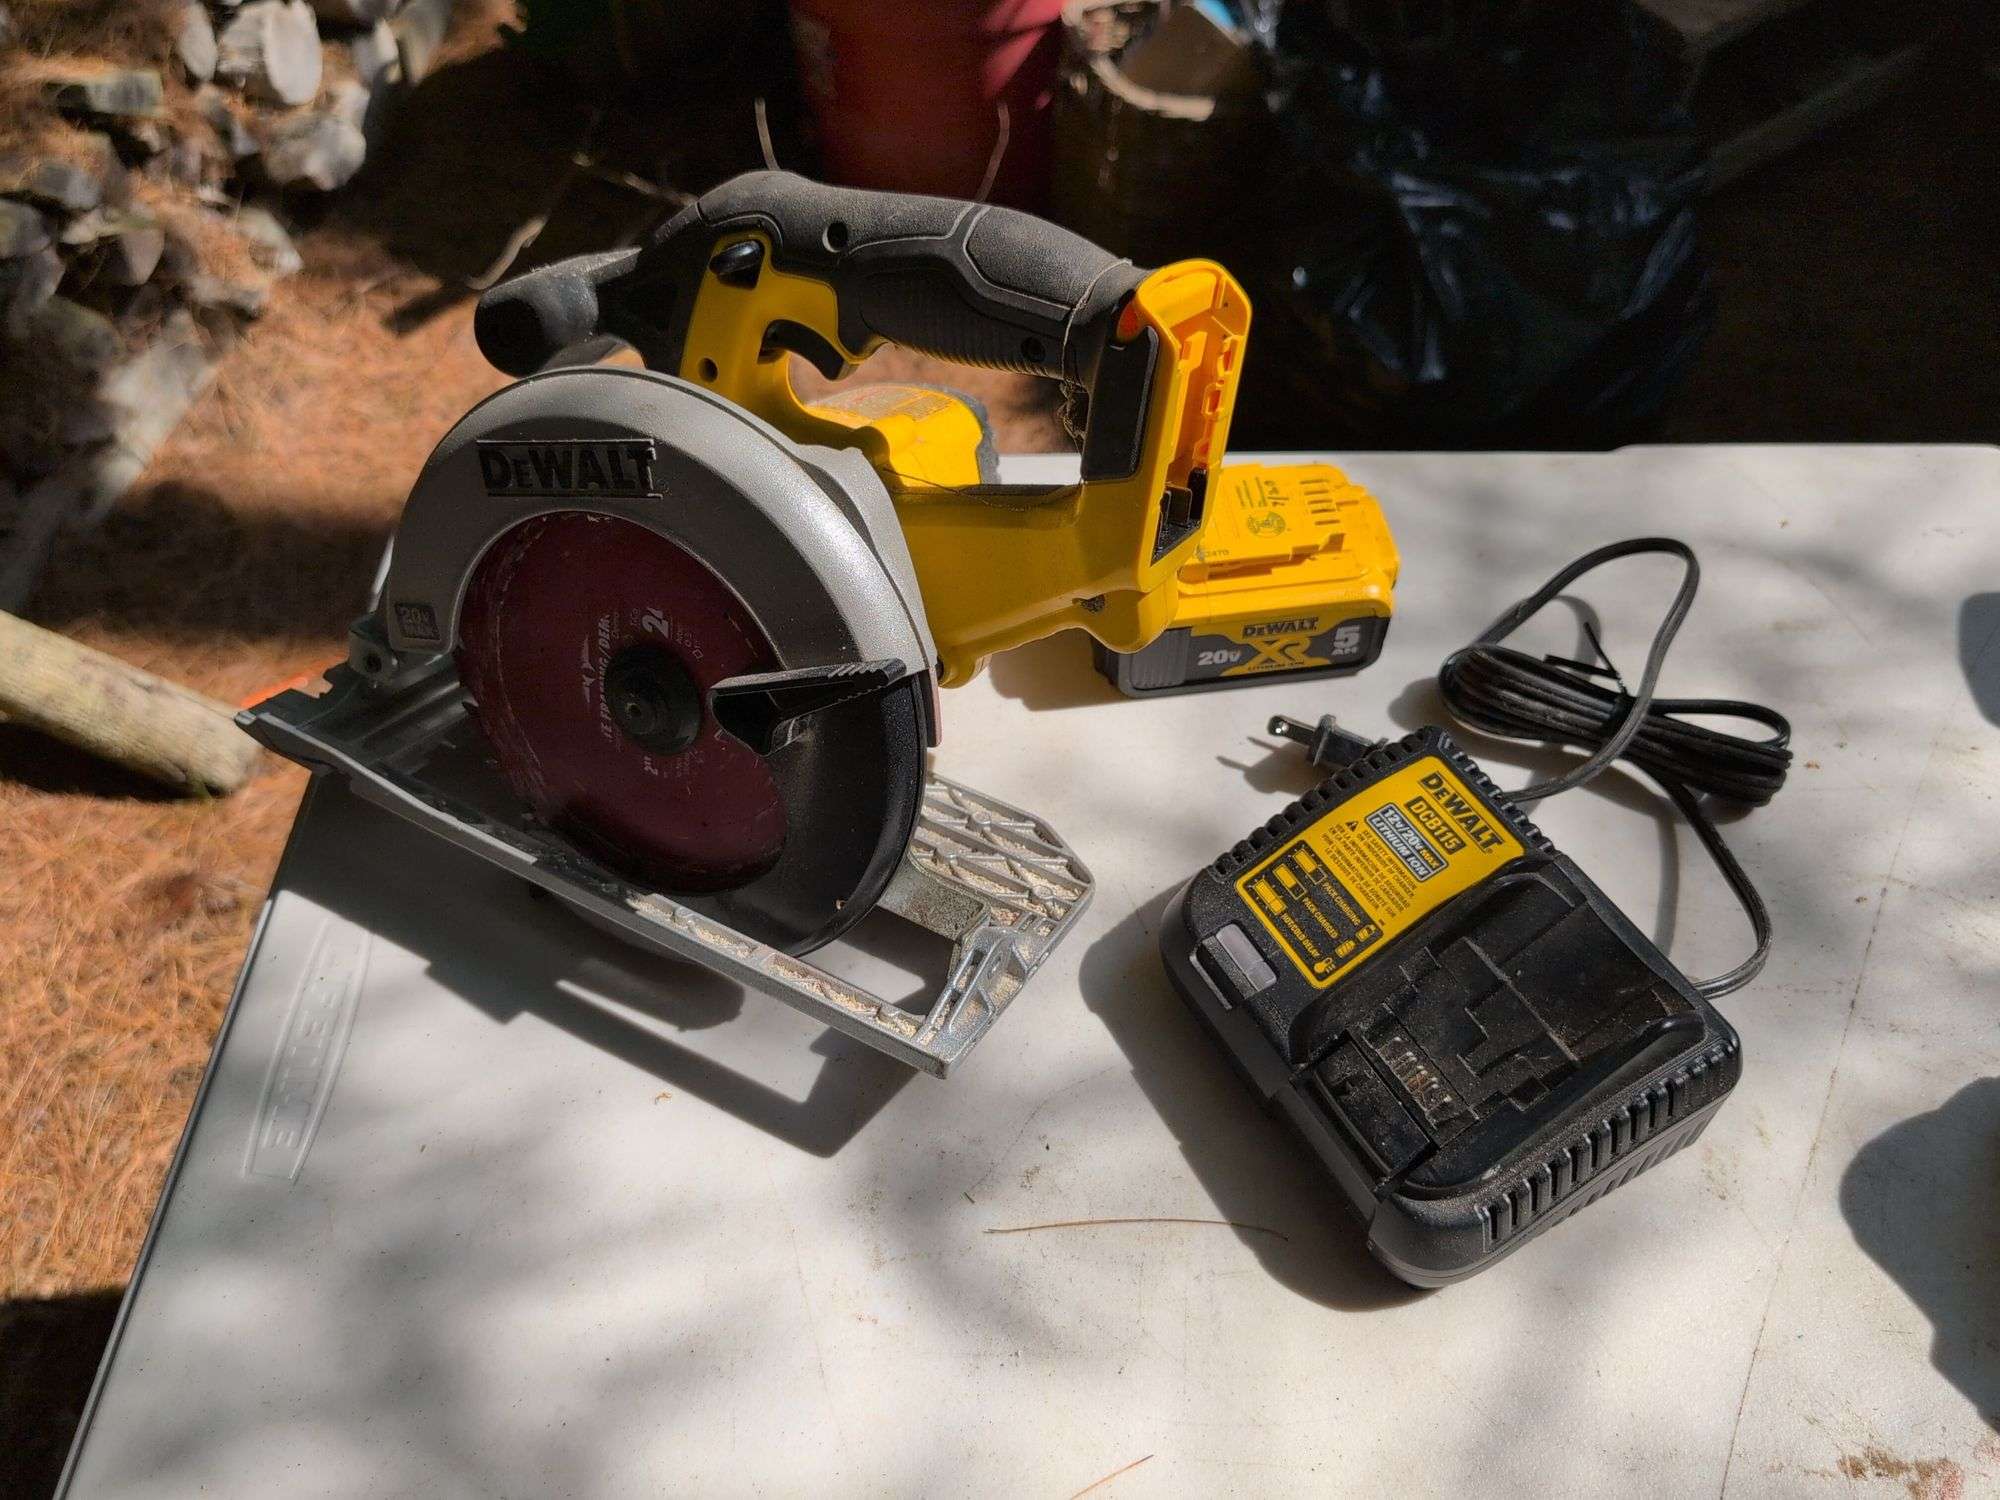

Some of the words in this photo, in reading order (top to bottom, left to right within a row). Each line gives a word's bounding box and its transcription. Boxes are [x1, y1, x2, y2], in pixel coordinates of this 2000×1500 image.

[479, 443, 657, 490] DEWALT
[1242, 617, 1319, 638] DEWALT
[1334, 625, 1361, 649] 5
[1408, 798, 1462, 851] DCB115
[1418, 769, 1503, 854] DEWALT
[1370, 815, 1411, 858] LITHIUM
[1404, 853, 1429, 877] ION
[1418, 847, 1440, 869] MAX
[1300, 895, 1319, 913] PACK
[1311, 909, 1340, 939] CHARGED
[1320, 880, 1339, 899] PACK
[1332, 894, 1362, 926] CHARGING
[1300, 937, 1321, 958] DELAY
